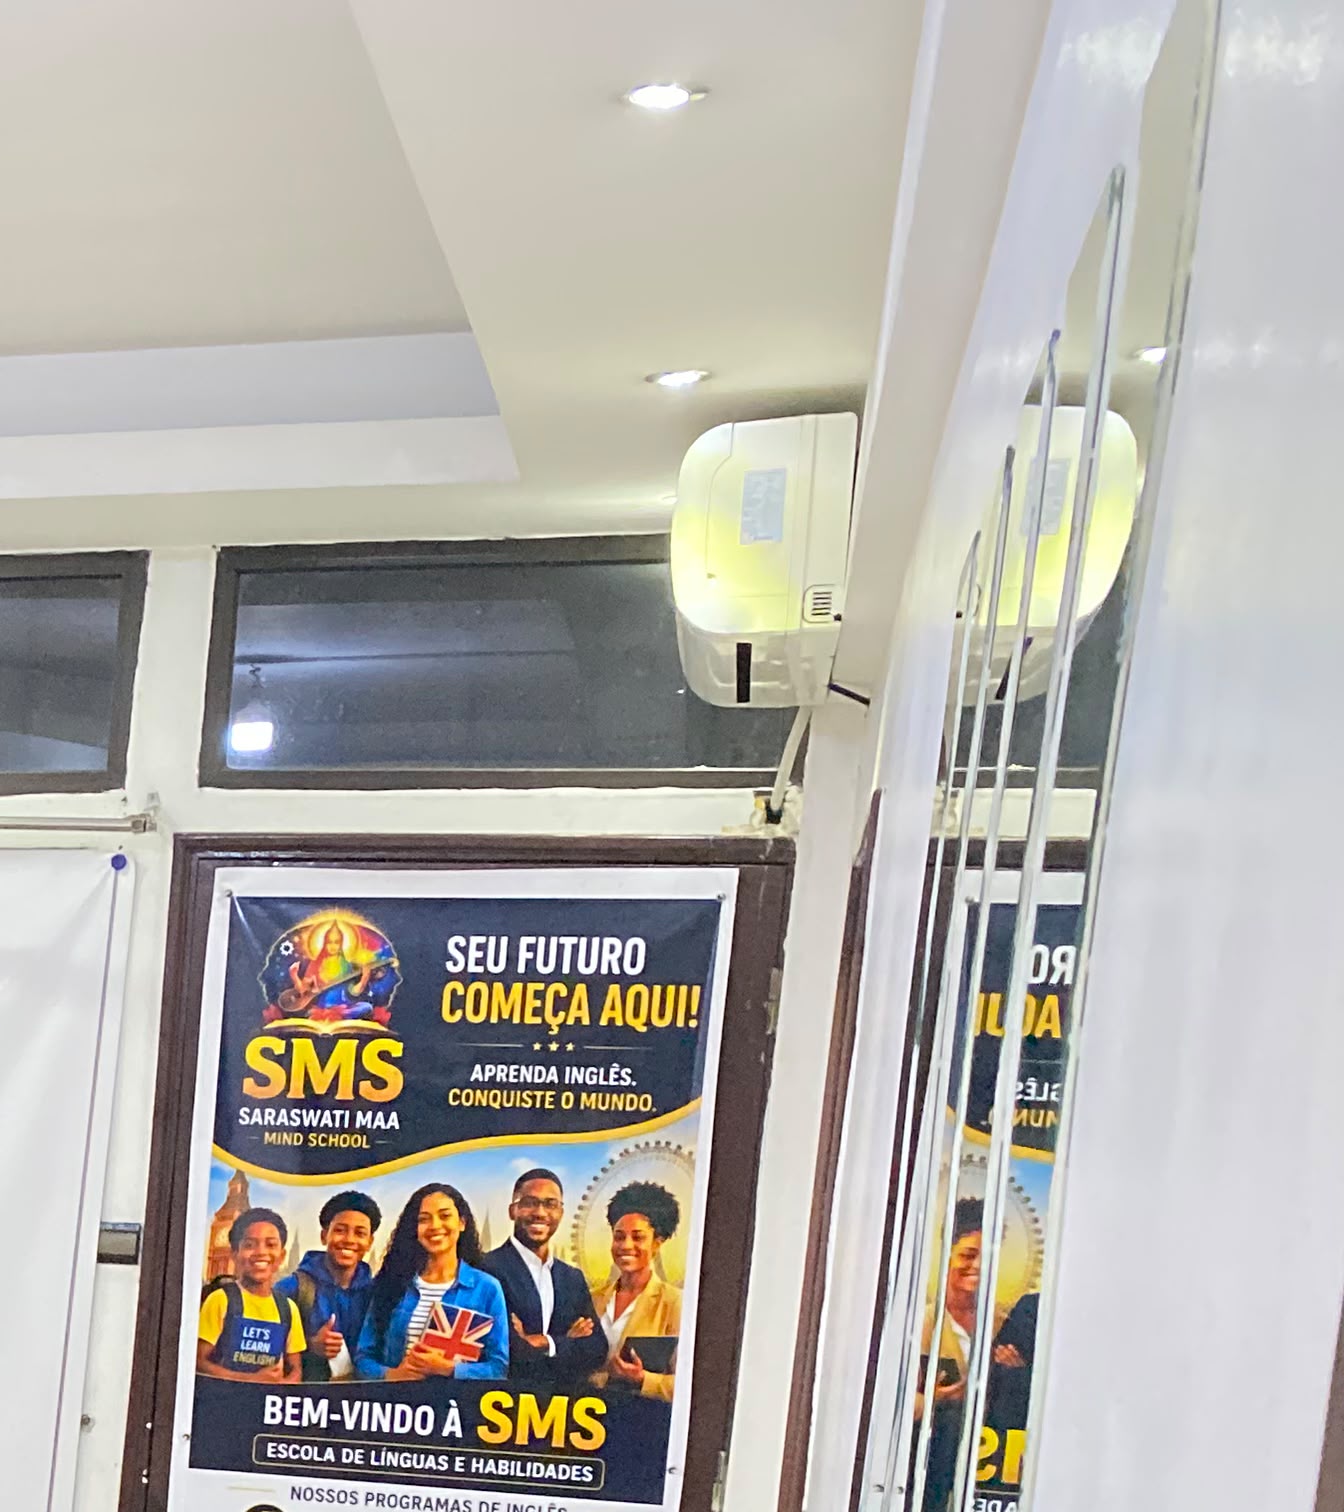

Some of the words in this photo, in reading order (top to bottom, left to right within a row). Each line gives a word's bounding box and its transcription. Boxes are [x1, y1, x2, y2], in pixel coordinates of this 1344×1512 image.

[445, 935, 509, 974] SEU
[517, 936, 646, 975] FUTURO
[441, 981, 591, 1035] COMEÇA
[599, 983, 701, 1033] AQUI!
[242, 1036, 404, 1102] SMS
[470, 1063, 559, 1084] APRENDA
[565, 1063, 637, 1086] INGLÊS.
[448, 1088, 556, 1109] CONQUISTE
[561, 1091, 575, 1109] O
[579, 1092, 657, 1112] MUNDO.
[238, 1107, 349, 1129] SARASWATI
[355, 1111, 400, 1130] MAA
[264, 1131, 304, 1146] MIND
[307, 1133, 371, 1149] SCHOOL
[243, 1326, 271, 1340] LET'S
[240, 1339, 271, 1353] LEARN
[263, 1394, 435, 1437] BEM-VINDO
[442, 1400, 463, 1438] À
[476, 1390, 607, 1451] SMS
[266, 1441, 335, 1463] ESCOLA
[342, 1447, 365, 1465] DE
[370, 1446, 448, 1472] LÍNGUAS
[454, 1456, 465, 1472] E
[471, 1457, 594, 1483] HABILIDADES
[290, 1486, 359, 1506] NOSSOS
